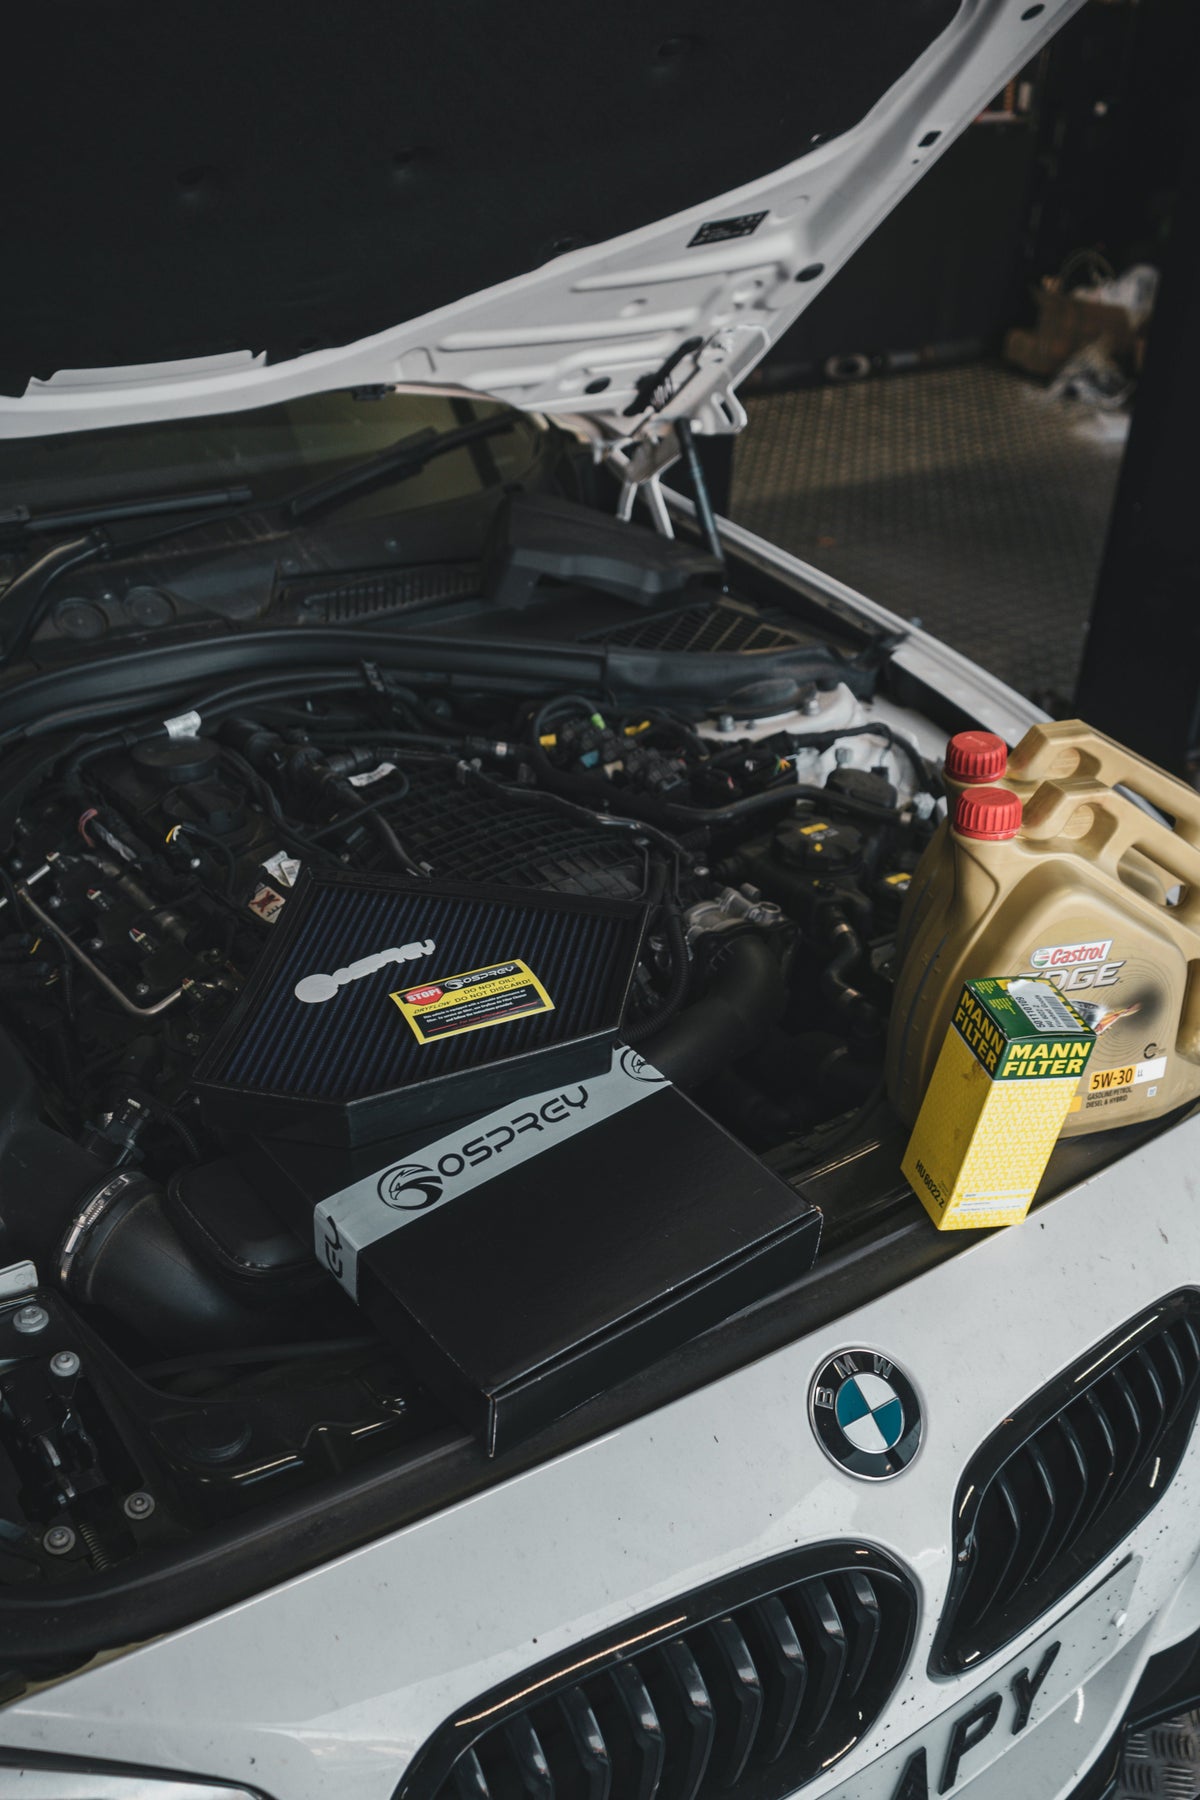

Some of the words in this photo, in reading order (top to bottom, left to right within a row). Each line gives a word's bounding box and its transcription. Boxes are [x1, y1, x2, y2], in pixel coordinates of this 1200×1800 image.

[1050, 943, 1106, 965] Castrol
[462, 966, 514, 984] OSPREY
[1018, 960, 1127, 992] DGE
[407, 988, 443, 1002] STOP!
[463, 986, 477, 994] DO
[470, 991, 487, 999] NOT
[489, 978, 532, 993] DISCARD!
[414, 1000, 451, 1014] DRYFLOW
[960, 990, 1004, 1056] MANN
[955, 1007, 998, 1073] FILTER
[1008, 1042, 1091, 1060] MANN
[1002, 1059, 1084, 1077] FILTER
[1092, 1068, 1133, 1091] 5W-30
[1085, 1100, 1103, 1109] DIESEL
[1109, 1094, 1129, 1104] HYBRID
[437, 1085, 589, 1177] OSPREY
[915, 1159, 926, 1178] HU
[923, 1173, 941, 1202] 6022
[815, 1354, 893, 1410] BMW
